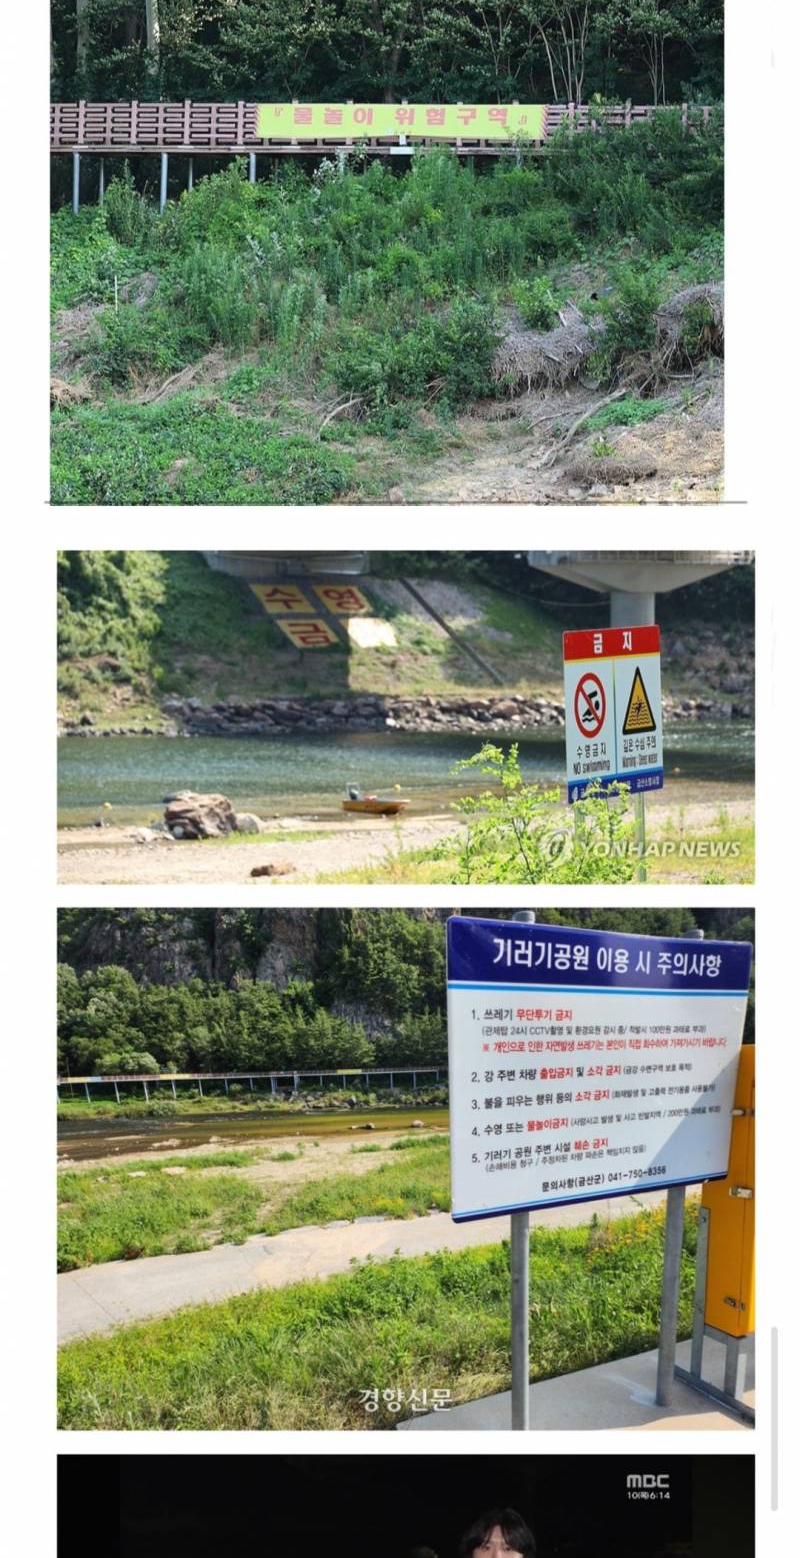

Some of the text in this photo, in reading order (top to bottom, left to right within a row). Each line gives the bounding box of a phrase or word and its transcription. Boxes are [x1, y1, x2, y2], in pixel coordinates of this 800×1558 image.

[593, 631, 632, 654] 금지
[493, 938, 721, 977] 기러기공원 이용 시 주의사항
[472, 1009, 573, 1021] 1. 쓰레기 무단투기 금지
[471, 1065, 621, 1083] 2. 강 주변 차량 출입금지 및 소각 금지
[471, 1099, 480, 1110] 3.
[484, 1096, 503, 1110] 불을
[506, 1095, 533, 1107] 피우는
[575, 1090, 591, 1102] 소각
[594, 1089, 610, 1101] 금지
[471, 1117, 568, 1137] 4. 수영 또는 물놀이금지
[471, 1153, 480, 1164] 5.
[484, 1148, 512, 1161] 기러기
[514, 1146, 532, 1158] 공원
[535, 1144, 551, 1156] 주변
[555, 1142, 571, 1153] 시설
[593, 1138, 609, 1149] 금지
